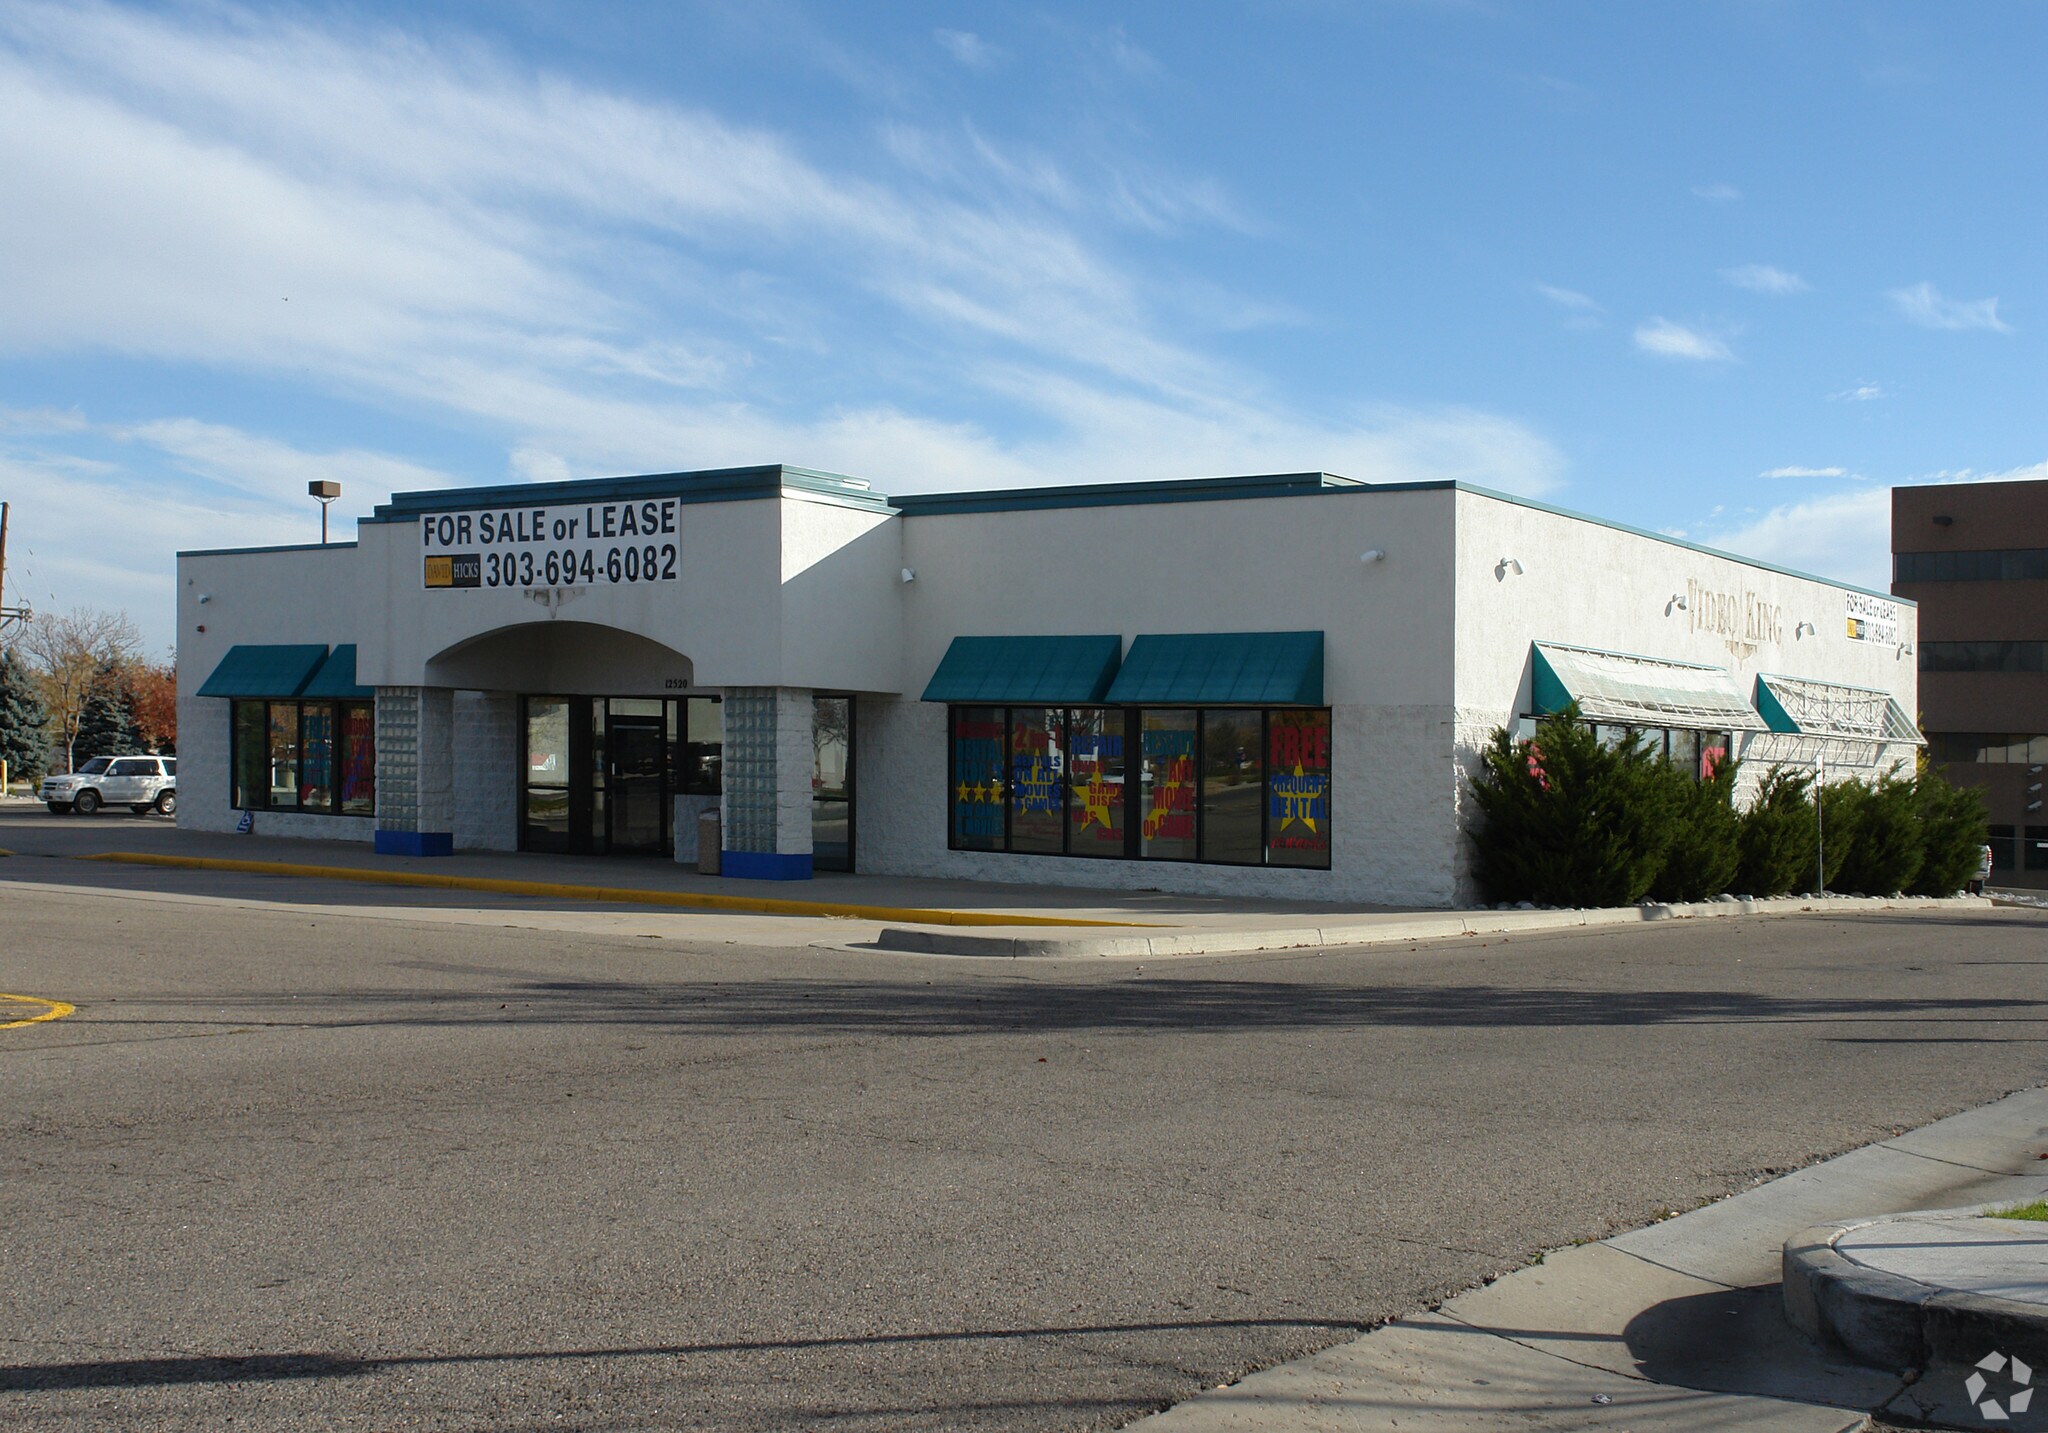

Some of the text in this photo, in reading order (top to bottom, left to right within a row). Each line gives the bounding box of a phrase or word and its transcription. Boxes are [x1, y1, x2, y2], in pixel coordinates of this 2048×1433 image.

[424, 501, 676, 546] FOR SALE or LEASE
[453, 562, 480, 578] HICKS
[665, 679, 688, 689] 12520
[1014, 722, 1025, 749] 2
[1072, 735, 1123, 756] REPAIR
[1270, 726, 1327, 768] FREE
[1014, 755, 1061, 767] RENTALS
[1169, 757, 1194, 783] ANY
[1013, 767, 1059, 782] ON ALL
[1270, 775, 1327, 793] FREQUENT
[1014, 783, 1061, 798] MOVIES
[1153, 786, 1194, 812] MOVIE
[1270, 797, 1327, 819] RENTAL
[1143, 819, 1156, 837] OR
